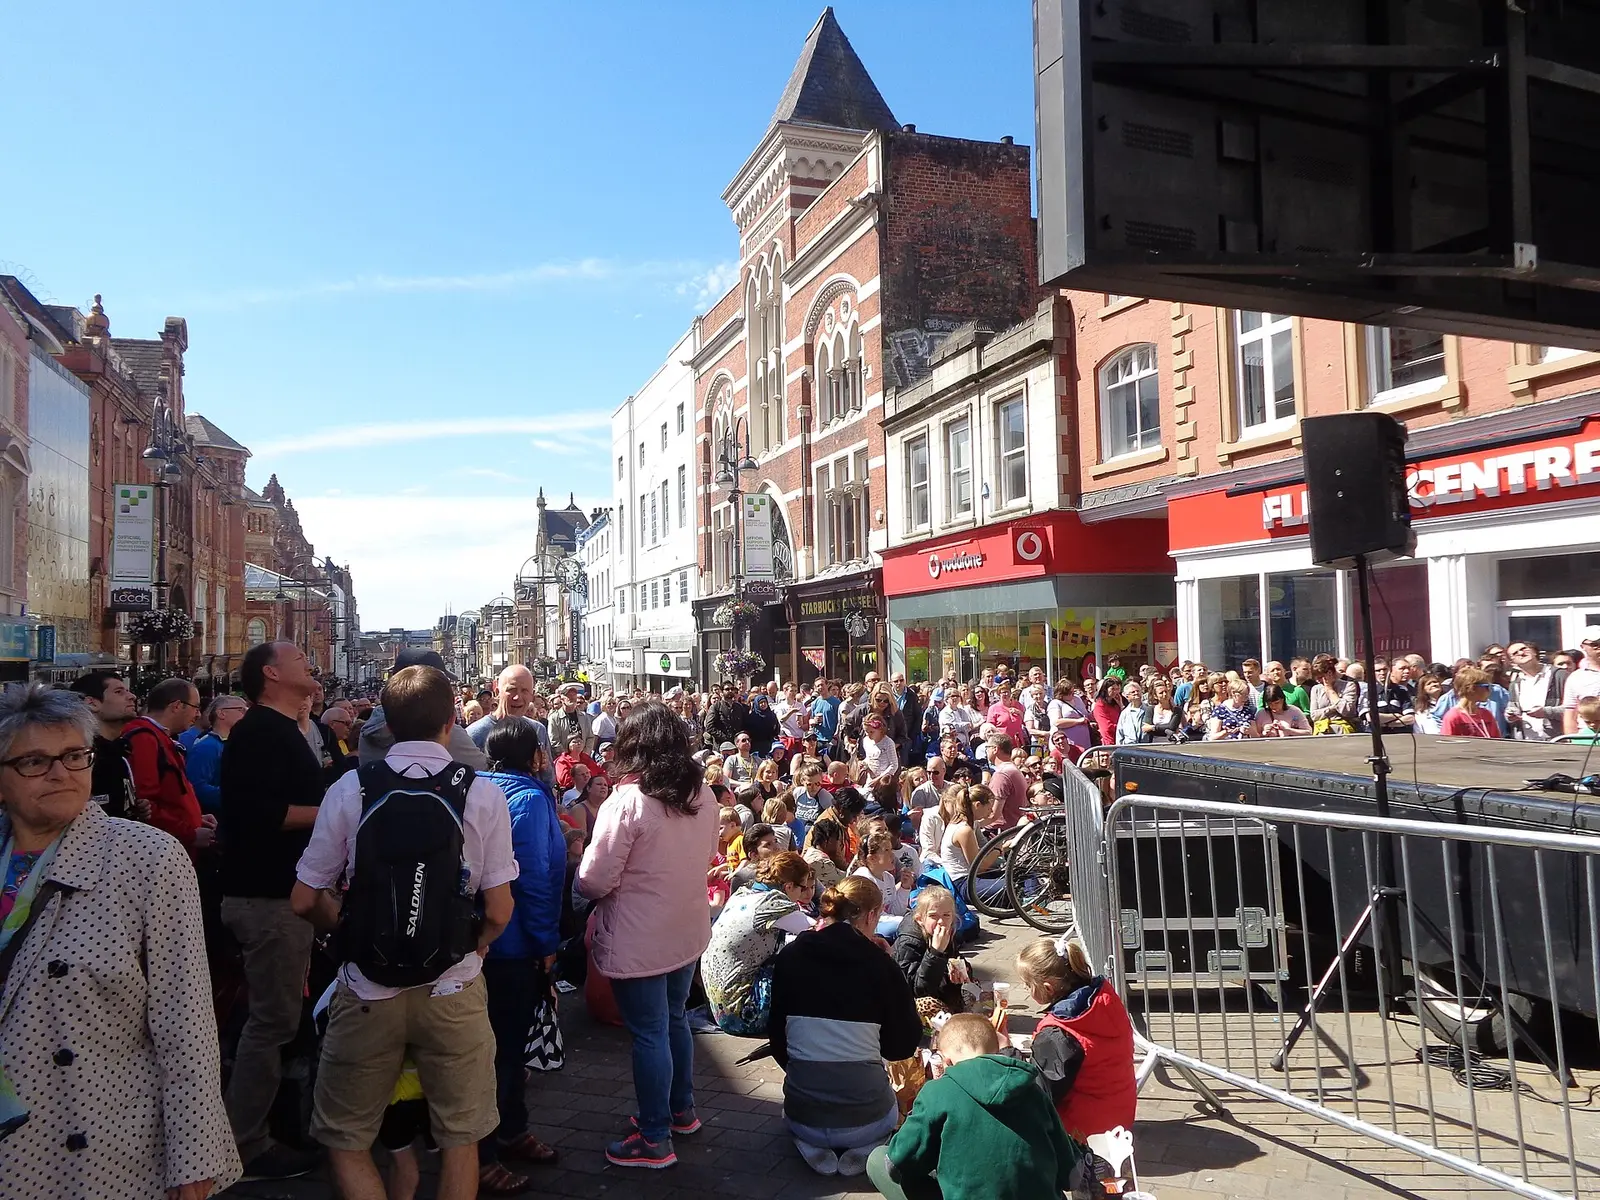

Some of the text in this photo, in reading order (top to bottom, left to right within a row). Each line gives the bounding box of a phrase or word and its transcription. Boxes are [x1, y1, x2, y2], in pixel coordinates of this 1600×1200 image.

[1406, 439, 1600, 506] CENTRE
[942, 551, 982, 571] vodafone
[406, 862, 426, 938] SALOMON
